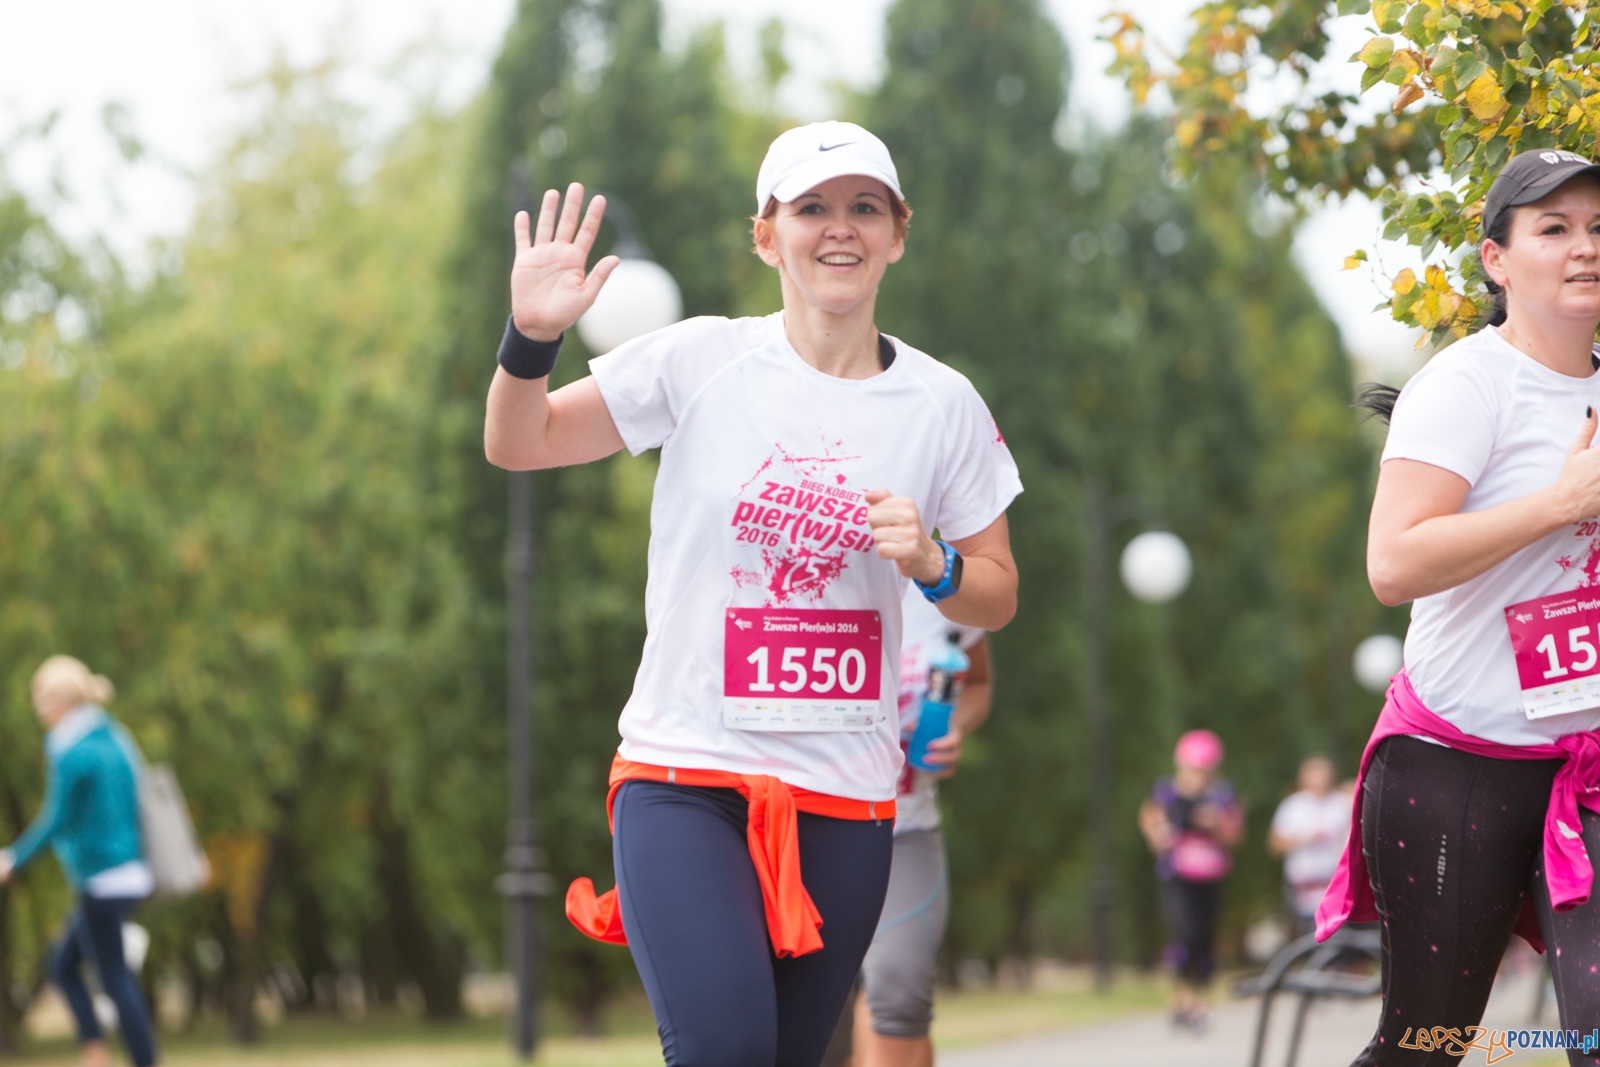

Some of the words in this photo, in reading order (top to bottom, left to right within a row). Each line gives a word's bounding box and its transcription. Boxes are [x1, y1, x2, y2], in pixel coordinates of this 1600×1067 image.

[800, 479, 825, 493] BIEG
[825, 486, 862, 502] KOBIET
[758, 481, 868, 526] zawsze
[736, 525, 781, 547] 2016
[1543, 604, 1577, 619] Zawsze
[763, 621, 799, 632] Zawsze
[837, 623, 859, 634] 2016
[1535, 622, 1600, 680] 15
[746, 646, 867, 694] 1550
